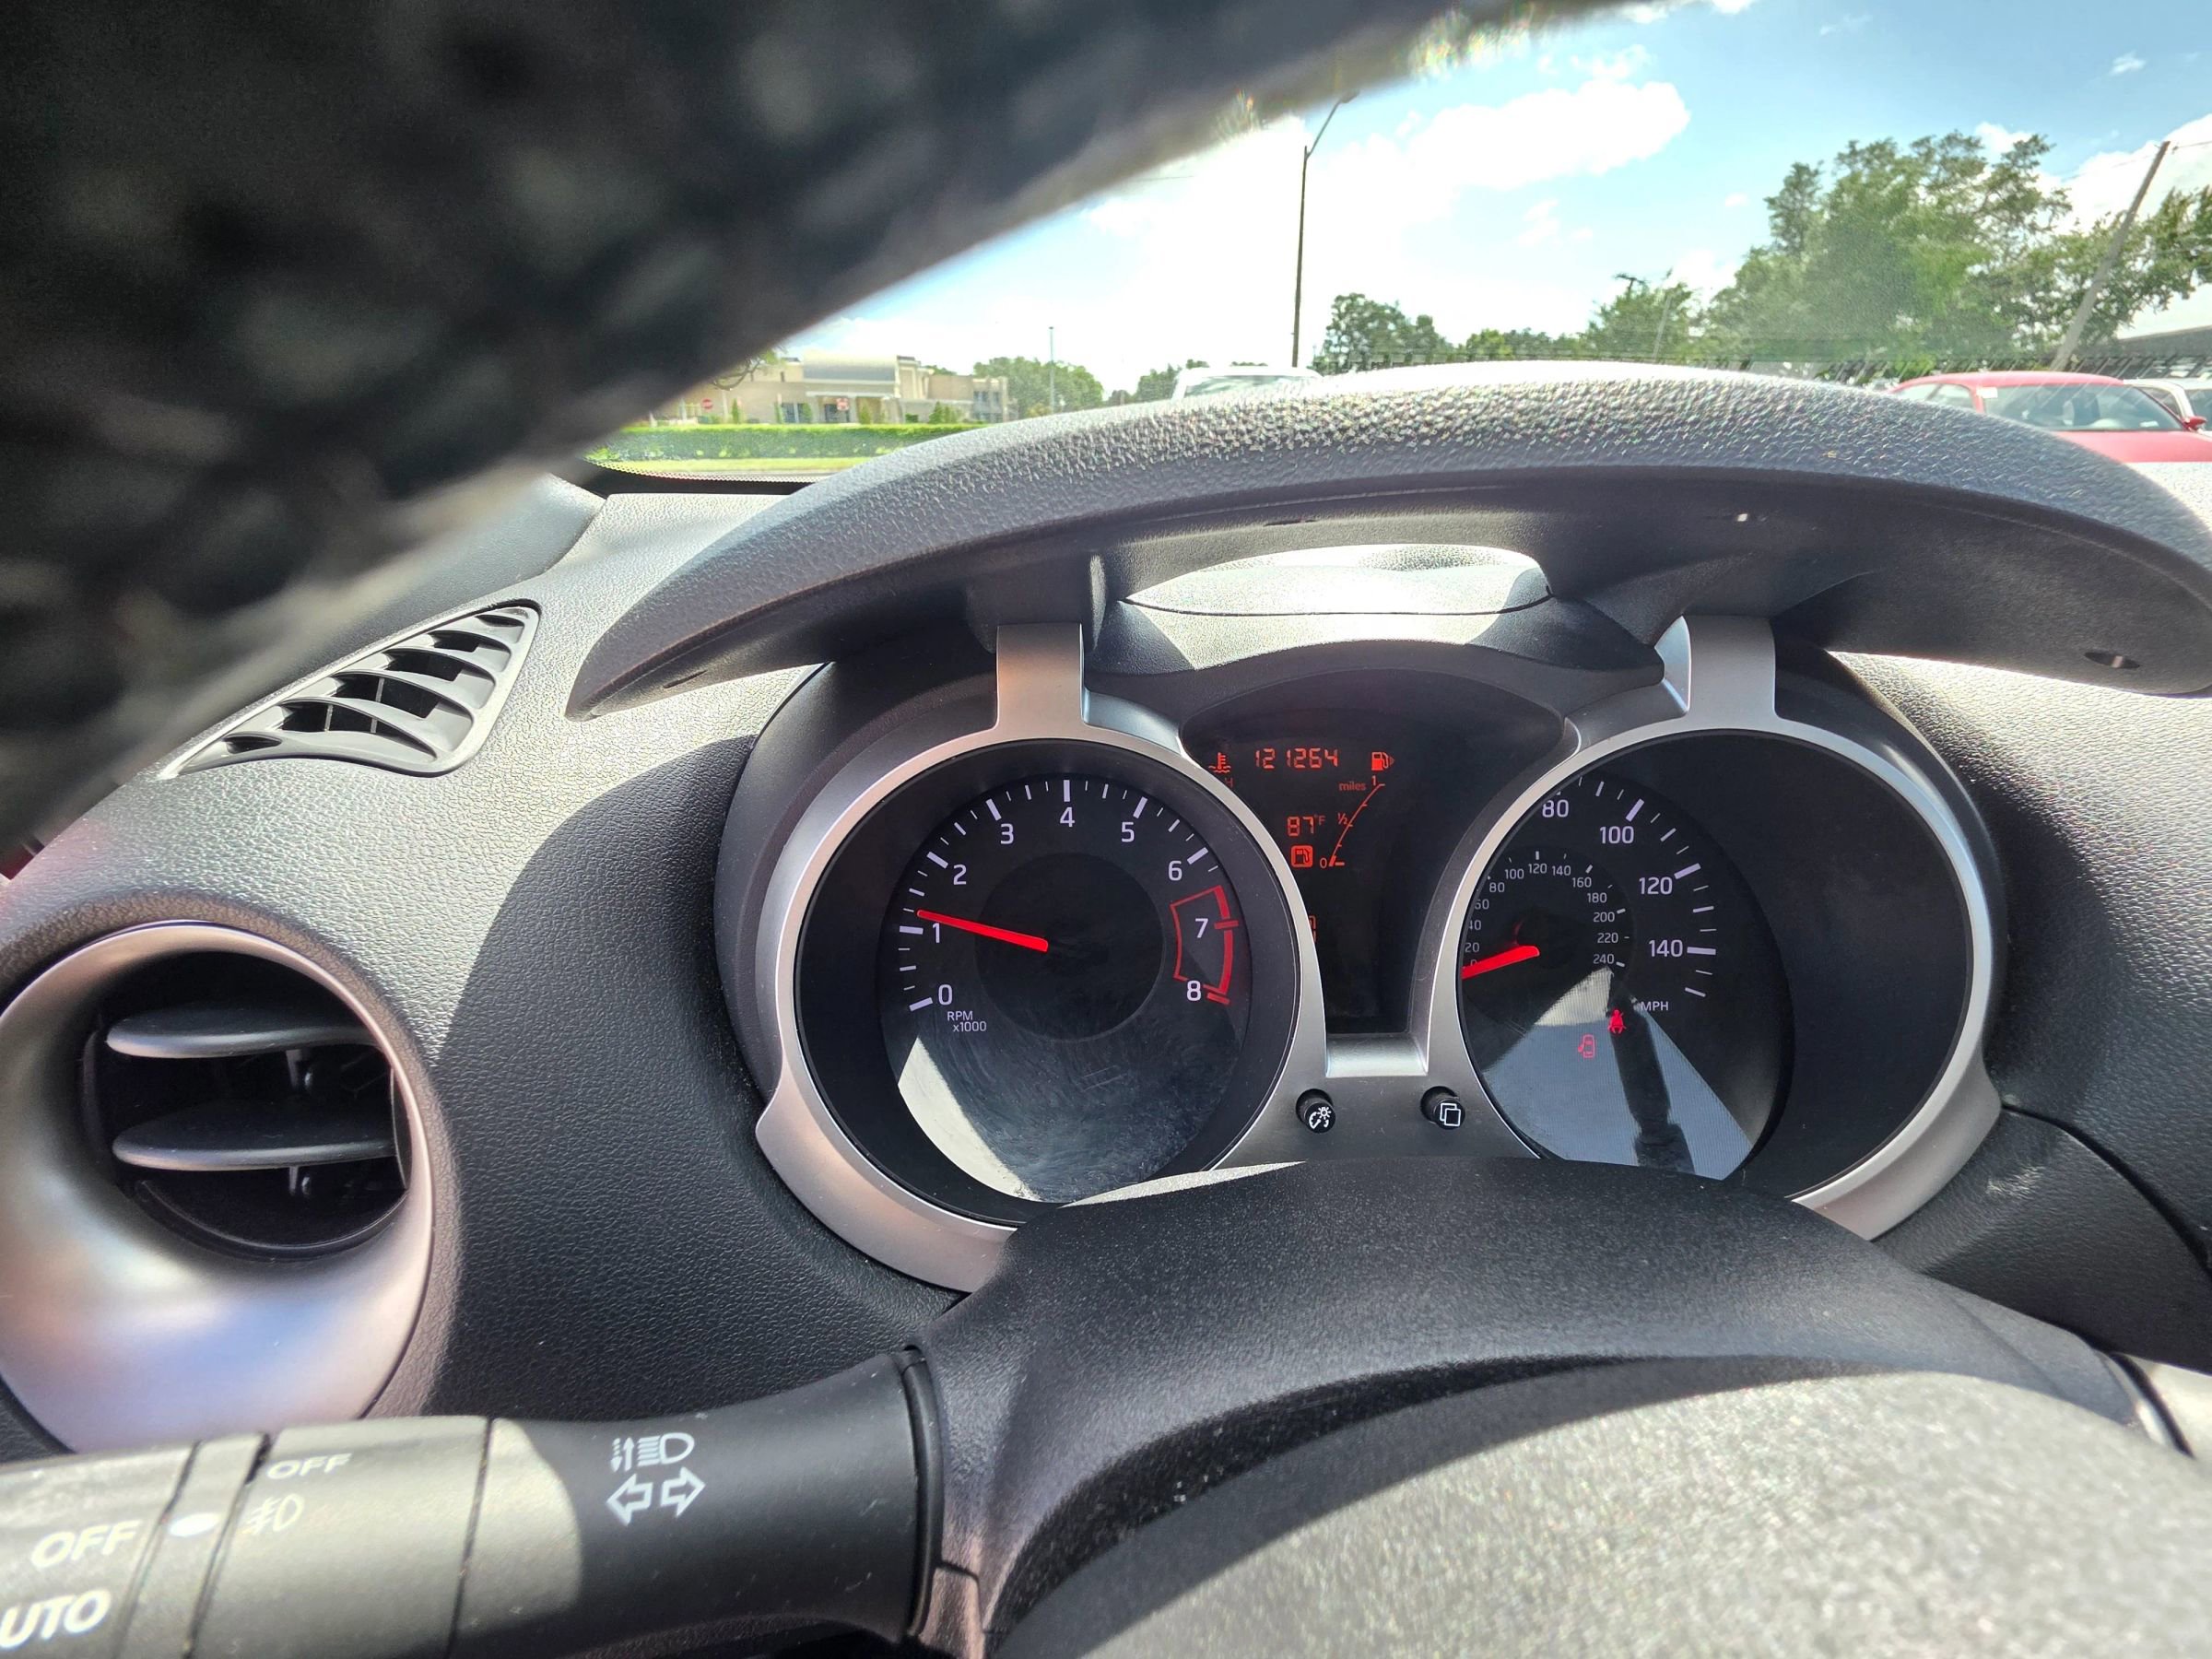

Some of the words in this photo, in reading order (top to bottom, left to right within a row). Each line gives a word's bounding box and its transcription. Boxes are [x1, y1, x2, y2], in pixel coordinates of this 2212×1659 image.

[1338, 781, 1367, 791] miles
[1059, 806, 1076, 828] 4
[1542, 799, 1570, 818] 80
[1000, 823, 1014, 844] 3
[1121, 822, 1135, 842] 5
[1599, 826, 1635, 844] 100
[953, 865, 967, 885] 2
[1168, 861, 1182, 881] 6
[1504, 868, 1524, 879] 100
[1527, 863, 1547, 875] 120
[1551, 865, 1571, 877] 140
[1488, 882, 1505, 893] 80
[1571, 877, 1592, 888] 160
[1639, 877, 1673, 895] 120
[1586, 892, 1607, 903] 180
[1593, 912, 1615, 923] 200
[932, 923, 941, 943] 1
[1195, 918, 1208, 938] 7
[1465, 942, 1480, 953] 20
[1597, 933, 1618, 944] 220
[1648, 940, 1684, 958] 140
[1593, 954, 1615, 965] 240
[938, 983, 953, 1006] 0
[1186, 981, 1201, 1001] 8
[1641, 1001, 1669, 1011] MPH
[947, 1010, 973, 1021] RPM
[953, 1021, 987, 1032] x1000
[267, 1453, 353, 1479] OFF
[30, 1520, 141, 1569] OFF
